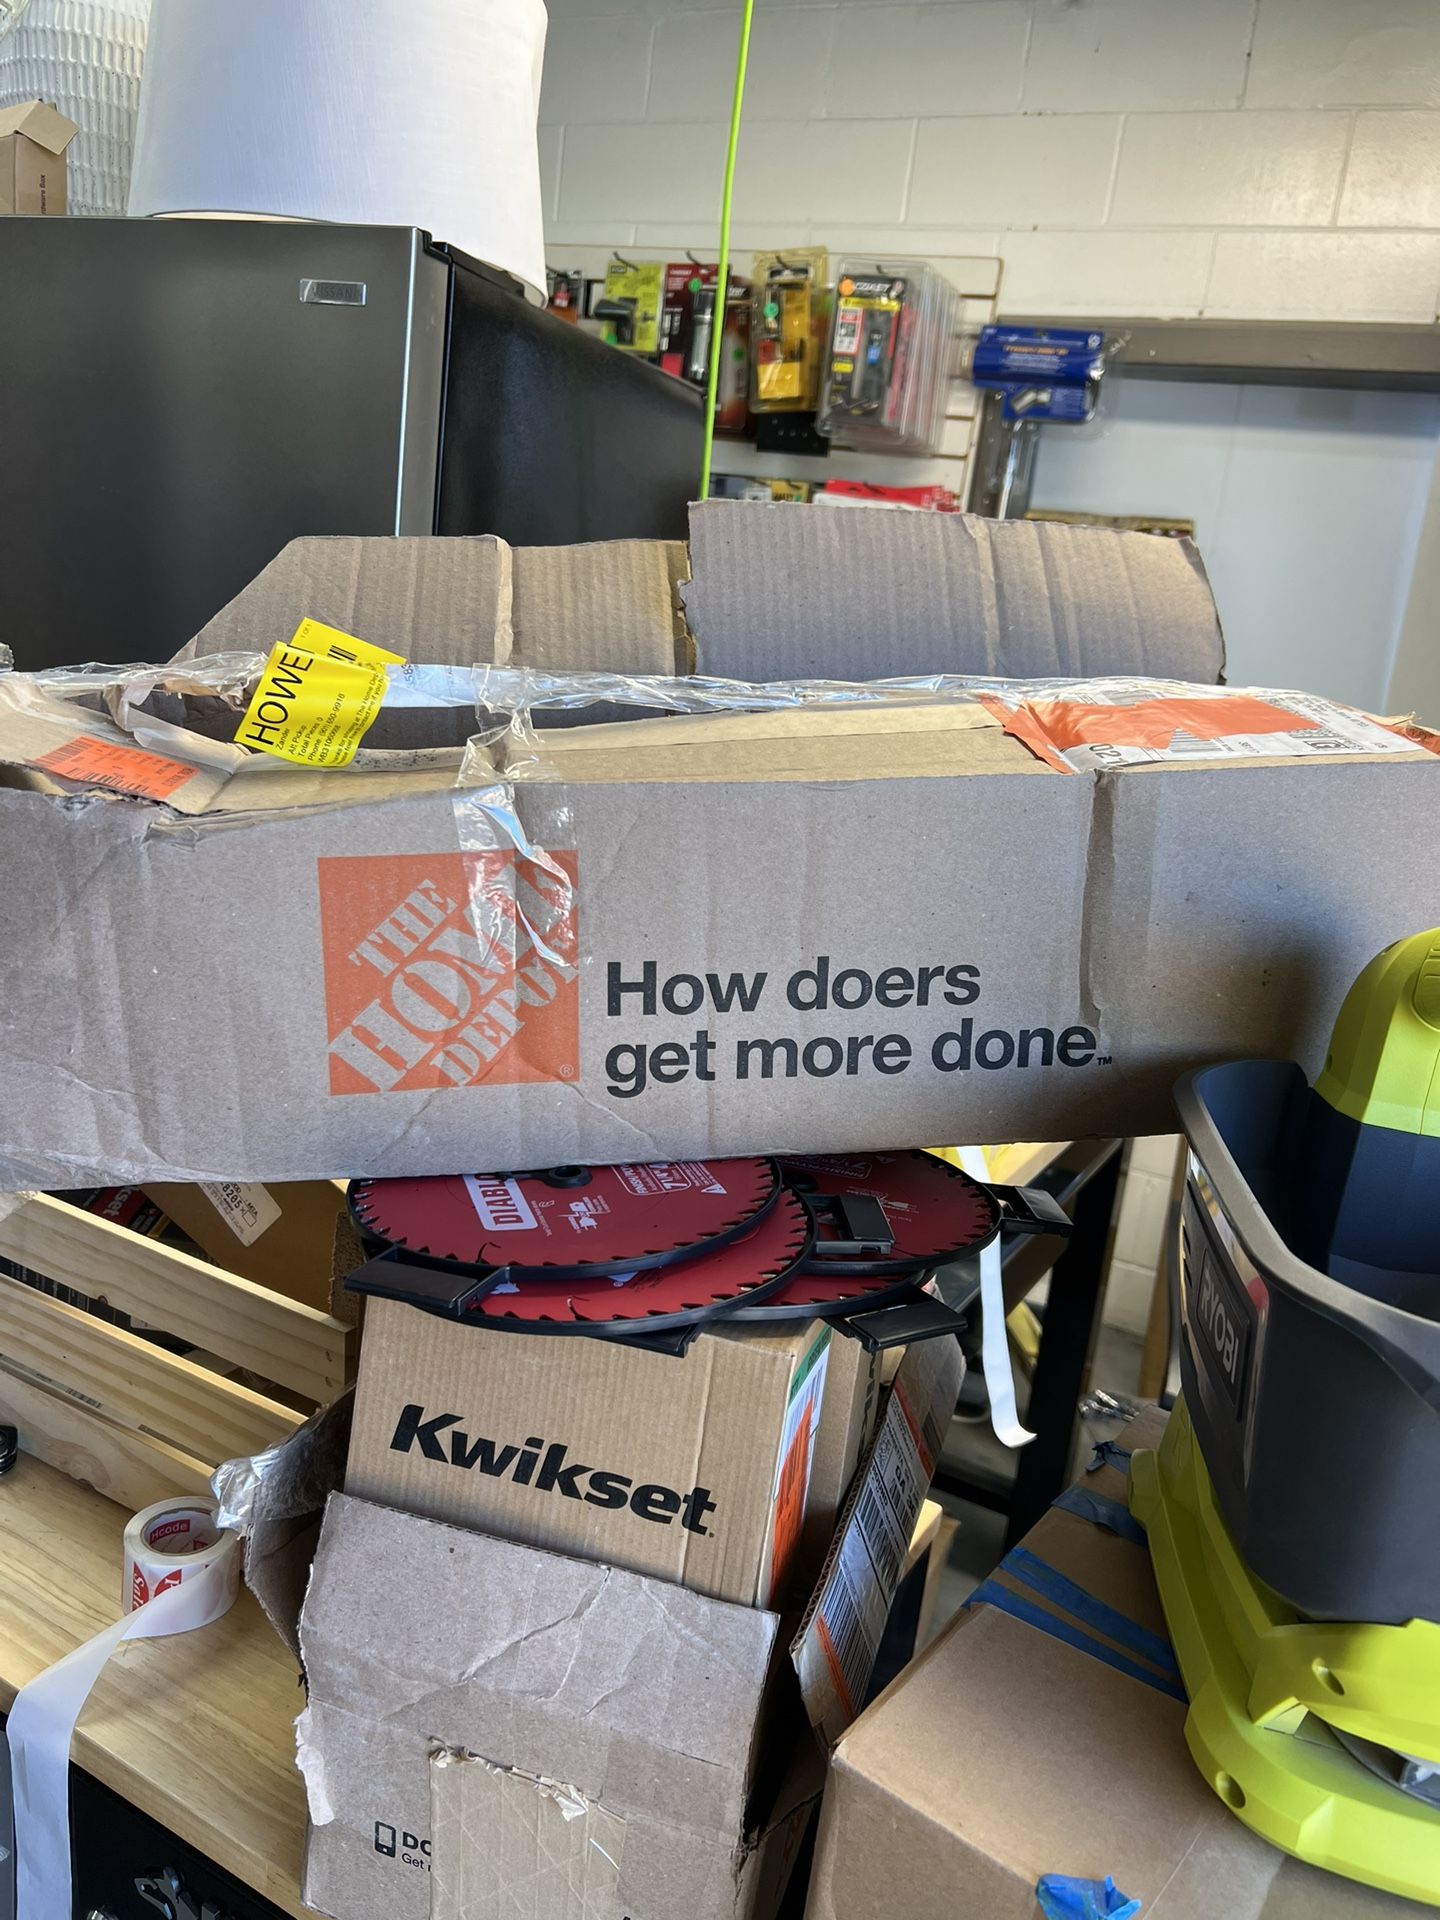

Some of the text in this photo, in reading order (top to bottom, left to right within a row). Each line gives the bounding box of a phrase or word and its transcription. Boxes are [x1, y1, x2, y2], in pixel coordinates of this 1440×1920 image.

[349, 879, 457, 978] THE
[430, 938, 579, 1087] DEPOT
[607, 956, 981, 1016] How doers
[605, 1030, 716, 1098] get
[736, 1033, 912, 1079] more
[1201, 1266, 1239, 1385] RYOBI
[389, 1404, 717, 1536] Kwikset
[401, 1852, 425, 1870] Get
